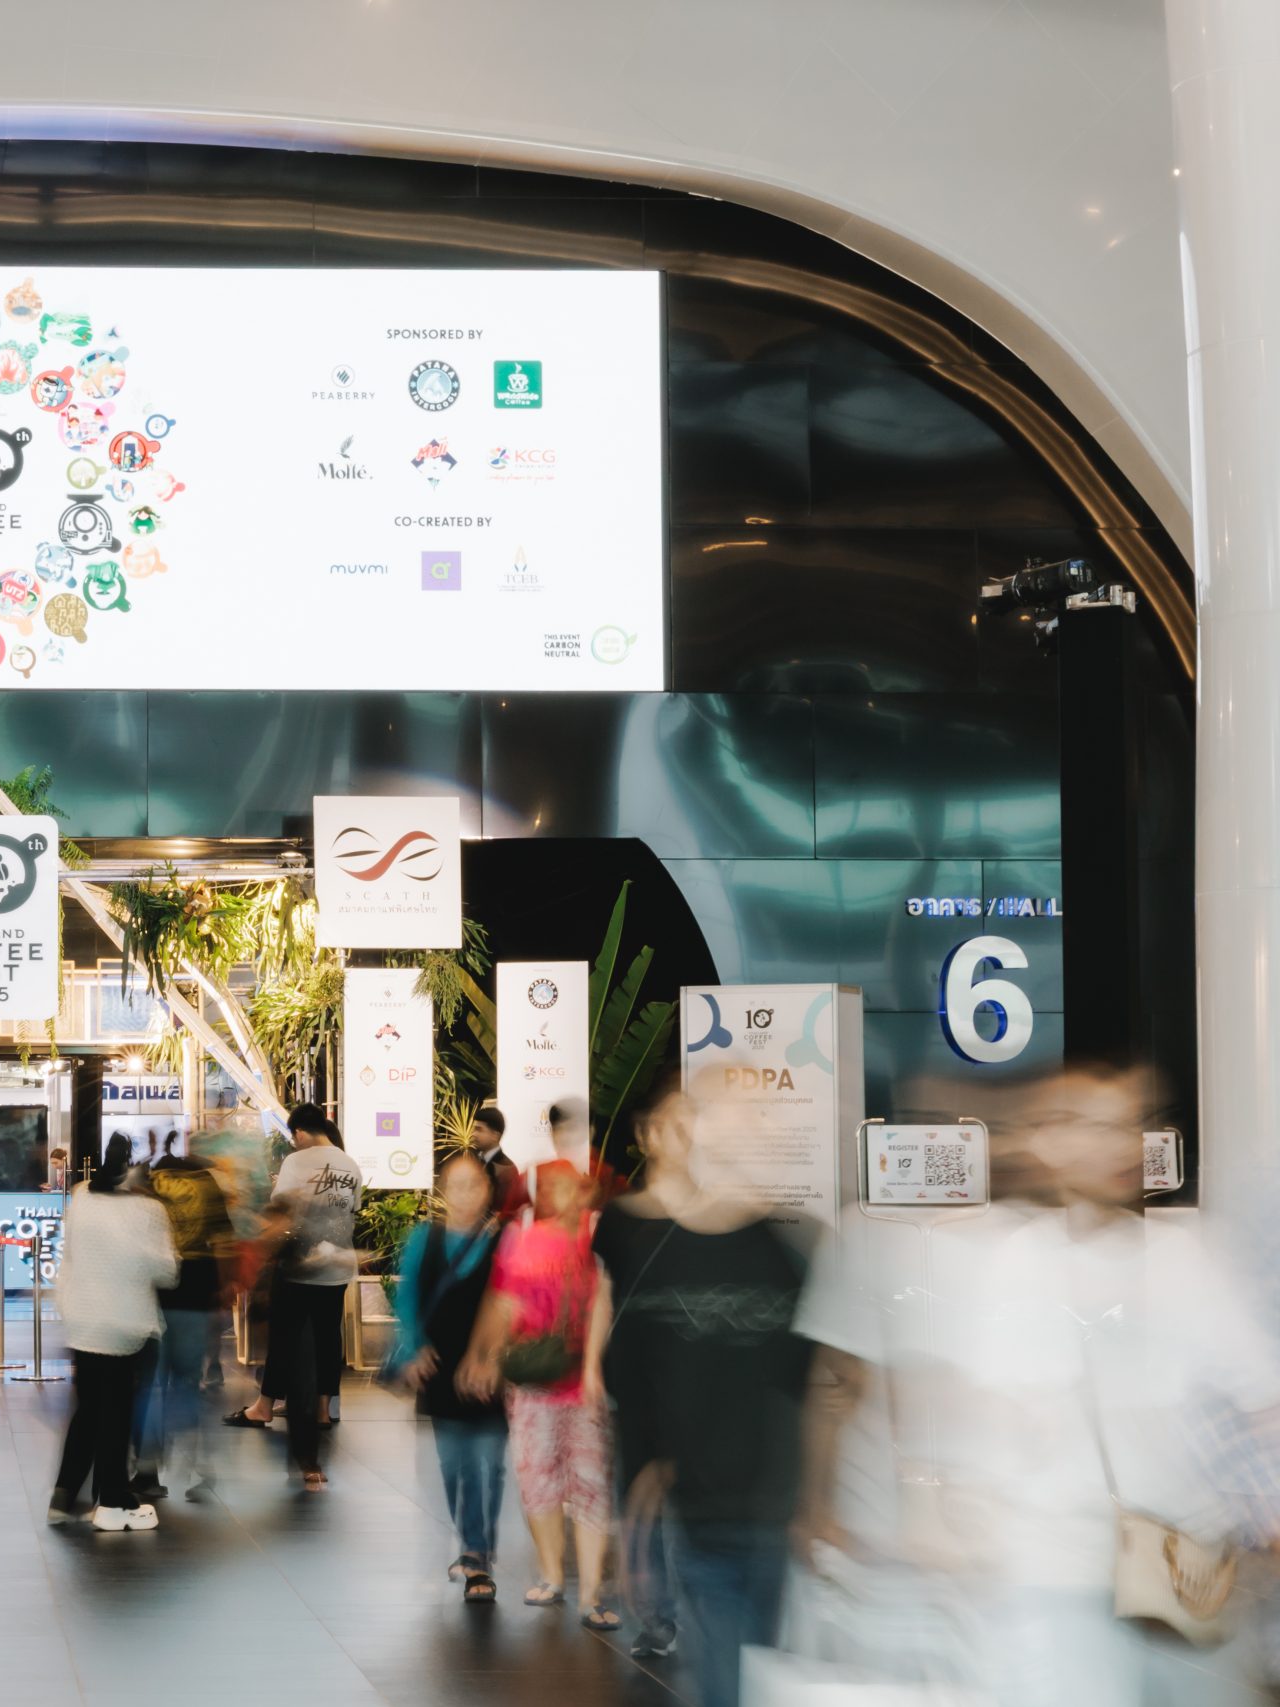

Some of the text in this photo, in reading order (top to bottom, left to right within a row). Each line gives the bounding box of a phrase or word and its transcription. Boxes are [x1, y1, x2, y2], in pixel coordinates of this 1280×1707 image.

[386, 328, 484, 340] SPONSORED BY
[311, 391, 376, 401] PEABERRY
[514, 450, 556, 463] KCG
[394, 515, 492, 528] CO-CREATED BY
[543, 641, 581, 649] CARBON
[544, 650, 581, 658] NEUTRAL
[344, 890, 431, 901] SCATH
[907, 898, 981, 916] อาคาร
[939, 935, 1033, 1063] 6
[539, 1067, 566, 1077] KCG
[724, 1068, 795, 1090] PDPA
